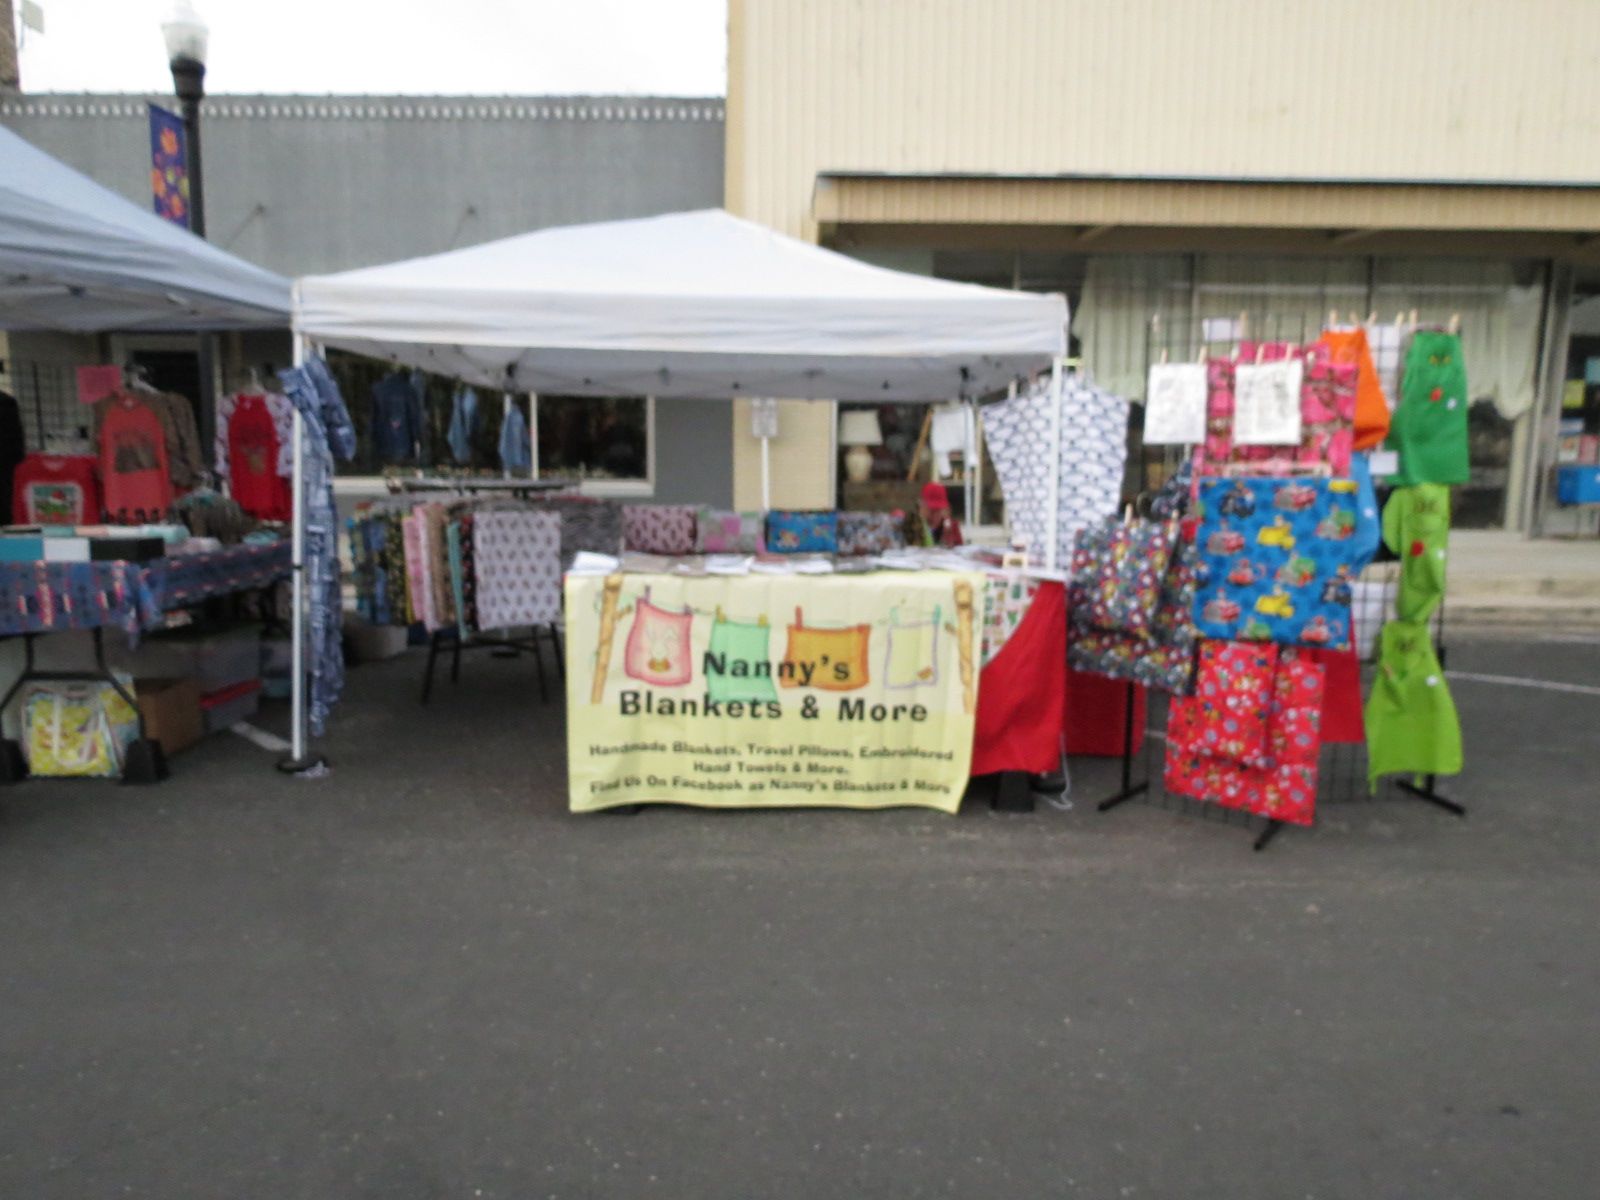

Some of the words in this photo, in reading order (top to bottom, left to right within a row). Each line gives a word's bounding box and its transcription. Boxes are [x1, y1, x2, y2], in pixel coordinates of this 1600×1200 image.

[703, 651, 850, 686] Nanny's
[620, 692, 782, 719] Blankets
[801, 696, 820, 720] &
[838, 698, 929, 722] More
[590, 743, 666, 757] Handmade
[747, 744, 793, 756] Travel
[860, 746, 953, 760] Embroidered
[694, 761, 731, 773] Hand
[736, 761, 786, 774] Towels
[792, 762, 802, 773] &
[590, 778, 621, 793] Find
[624, 777, 641, 787] Us
[647, 775, 666, 786] On
[672, 776, 742, 790] Facebook
[749, 782, 764, 790] as
[770, 780, 827, 792] Nanny's
[834, 780, 895, 792] Blankets
[901, 781, 908, 789] &
[914, 781, 950, 794] More
